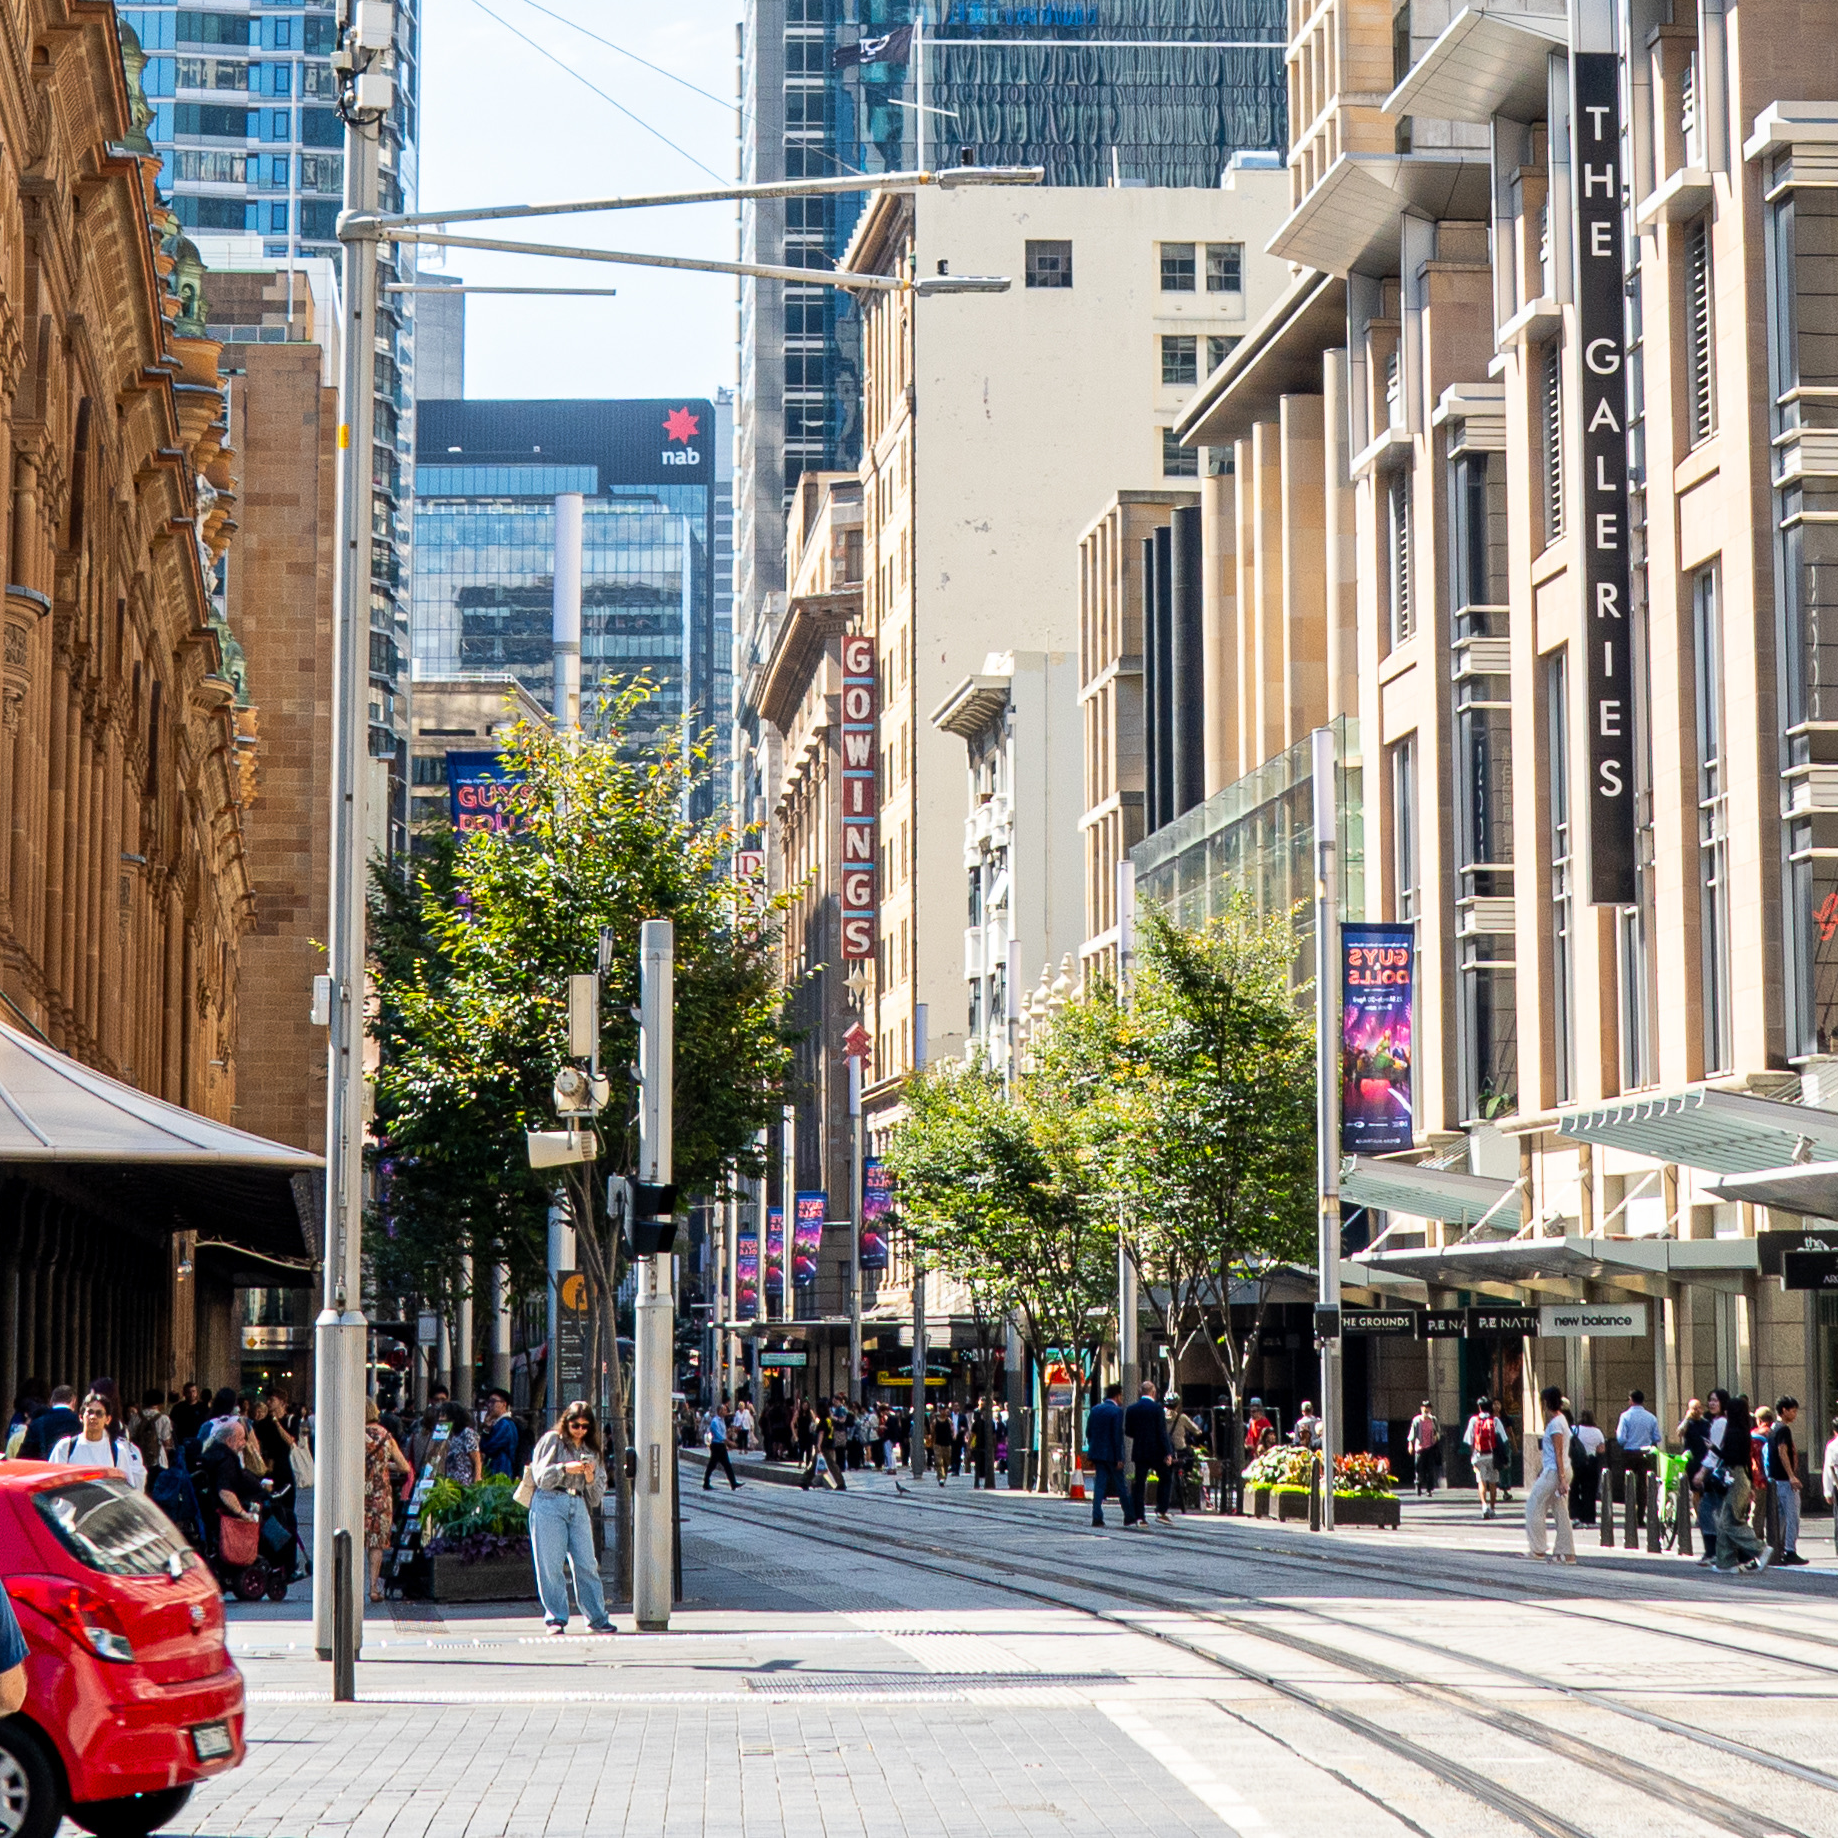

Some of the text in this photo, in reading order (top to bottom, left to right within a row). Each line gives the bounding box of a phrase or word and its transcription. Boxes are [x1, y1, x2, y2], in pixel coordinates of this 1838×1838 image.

[662, 447, 700, 465] nab
[1583, 105, 1624, 799] THE GALERIES
[845, 640, 871, 954] GOWINGS
[1359, 1317, 1410, 1327] GROUNDS
[1500, 1317, 1540, 1329] NATI
[1554, 1314, 1632, 1327] new balance
